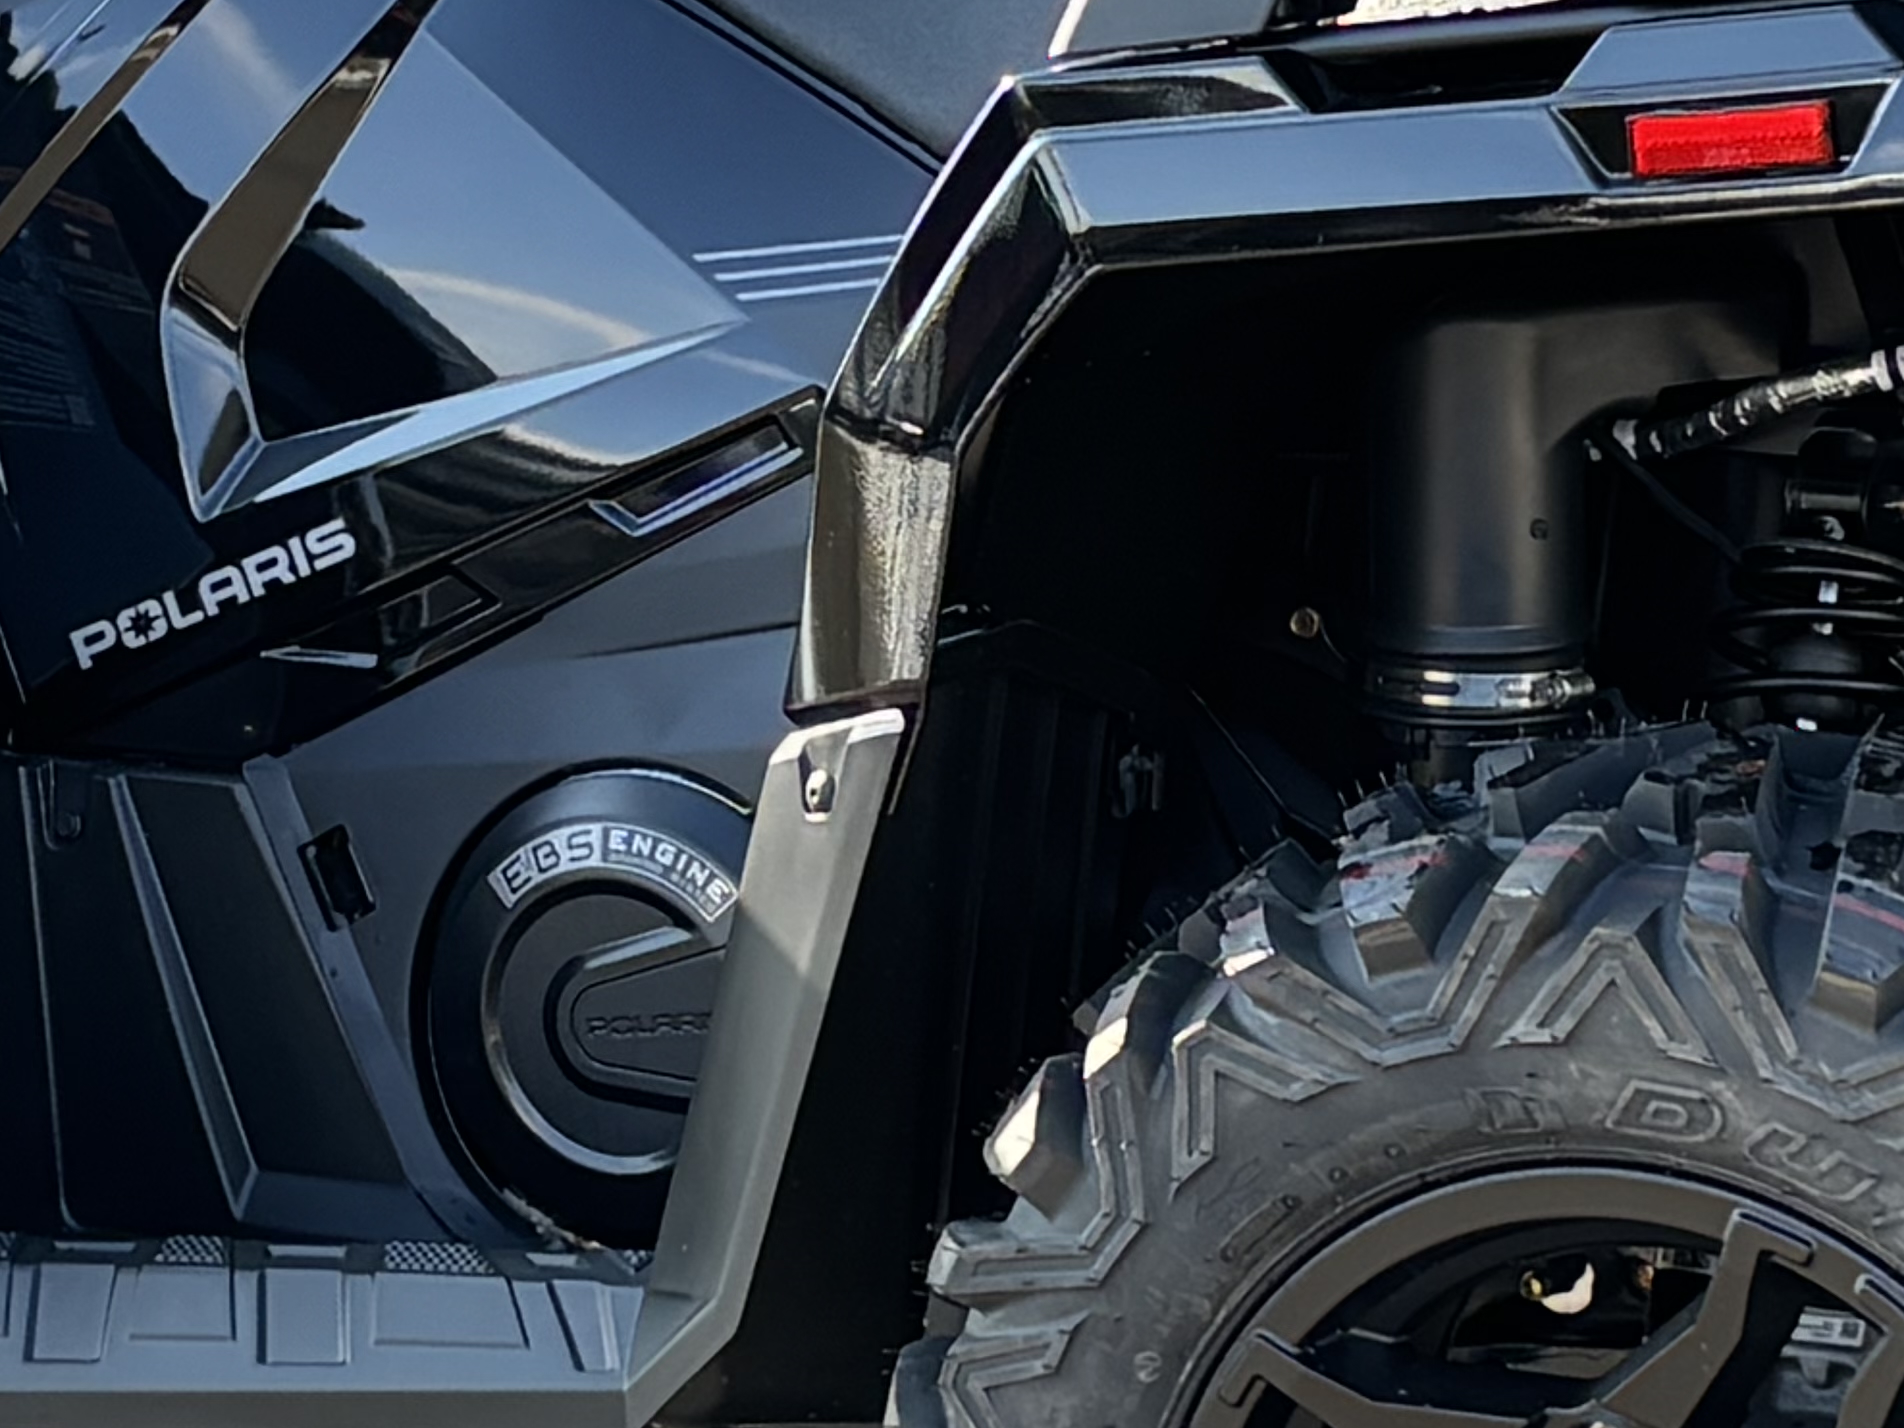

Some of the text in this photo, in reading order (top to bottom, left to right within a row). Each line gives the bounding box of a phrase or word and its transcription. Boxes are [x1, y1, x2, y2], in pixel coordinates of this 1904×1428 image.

[68, 517, 356, 670] POLARIS
[500, 828, 595, 895] EBS
[607, 829, 730, 905] ENGINE
